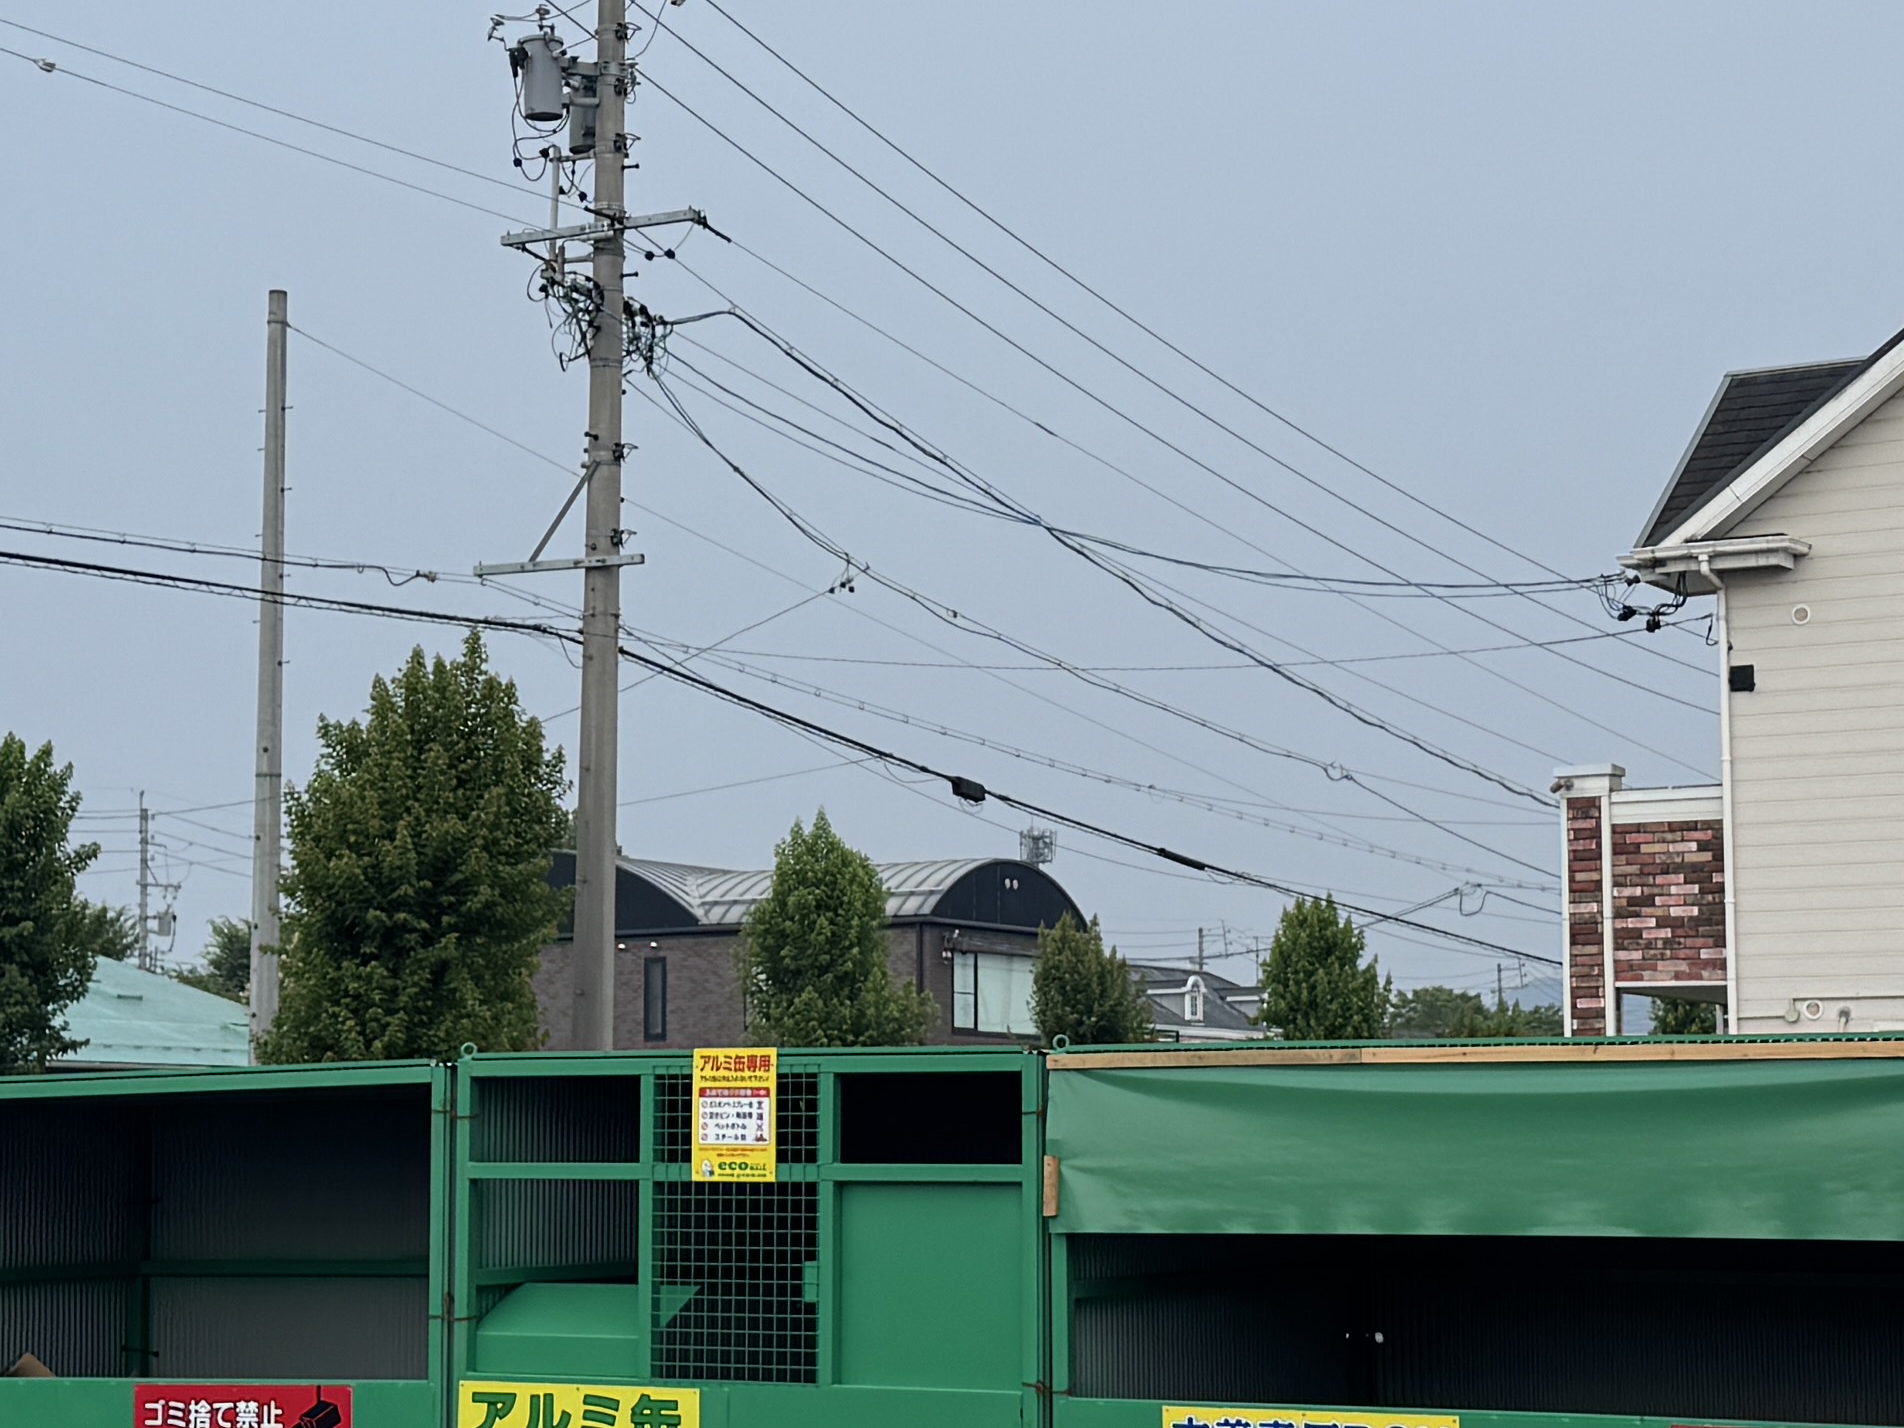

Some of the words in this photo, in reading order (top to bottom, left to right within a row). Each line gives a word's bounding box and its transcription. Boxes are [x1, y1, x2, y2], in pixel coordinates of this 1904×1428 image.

[700, 1054, 771, 1072] アルミ缶専用
